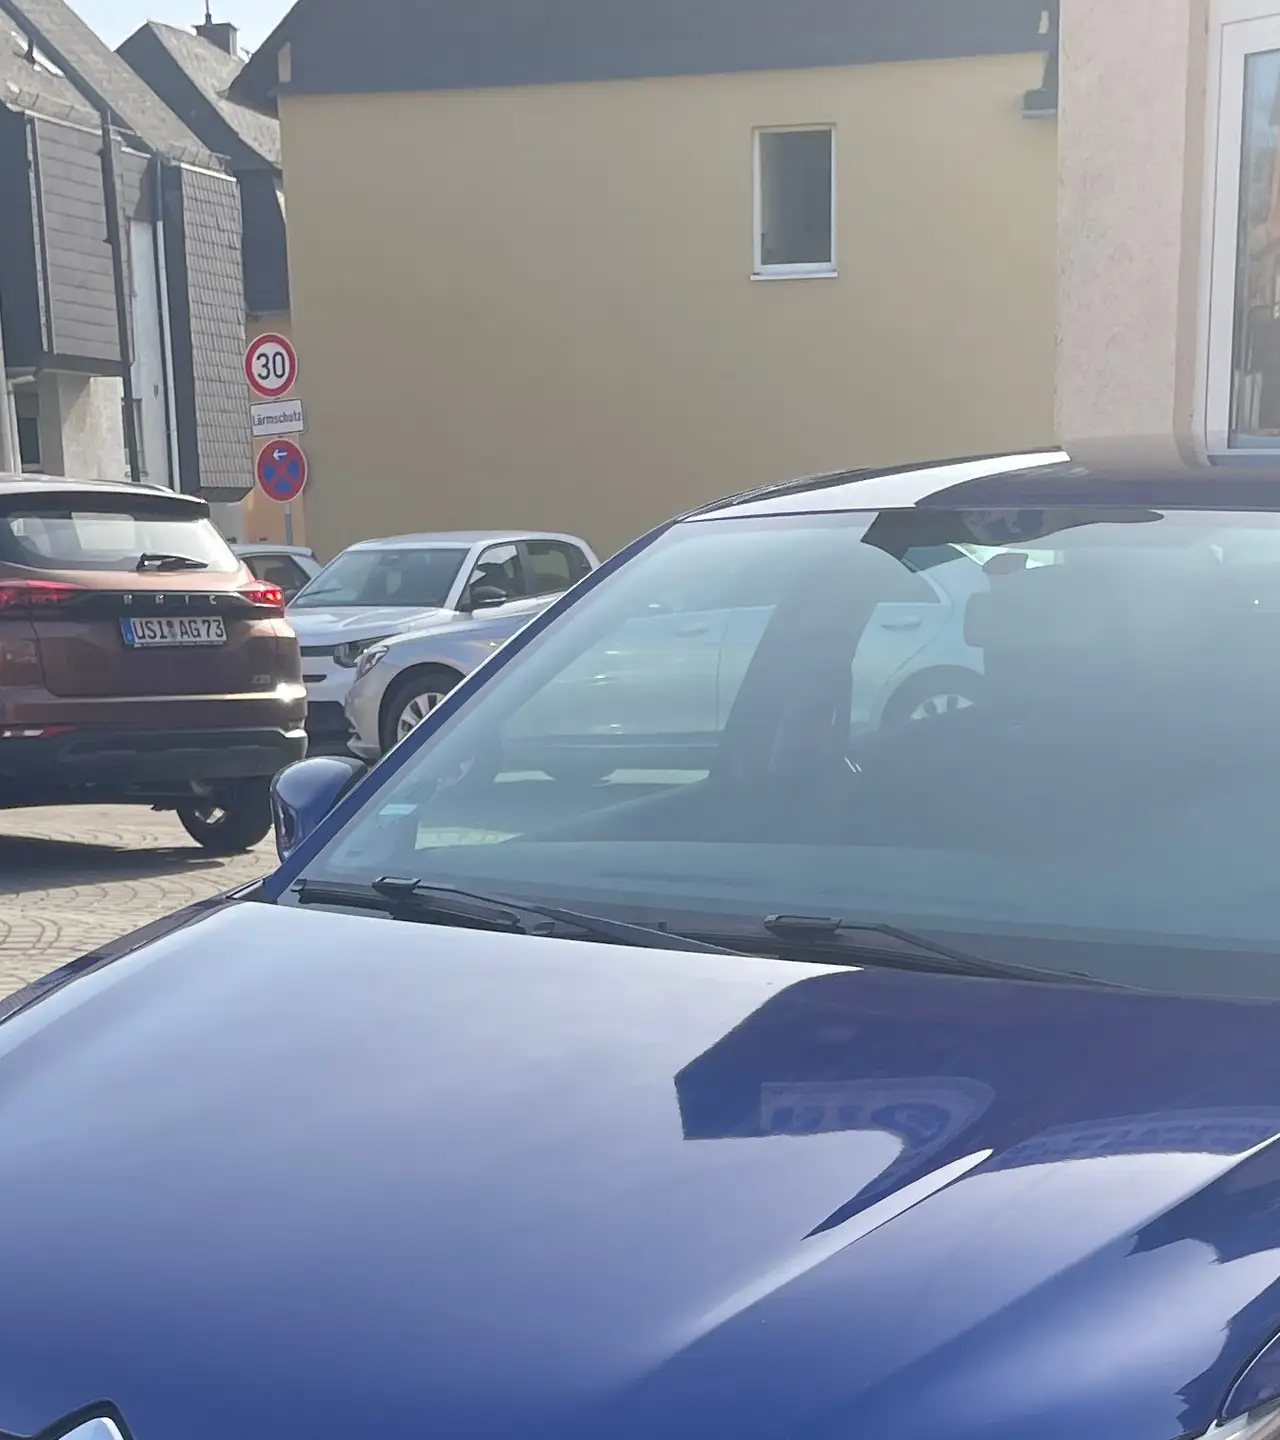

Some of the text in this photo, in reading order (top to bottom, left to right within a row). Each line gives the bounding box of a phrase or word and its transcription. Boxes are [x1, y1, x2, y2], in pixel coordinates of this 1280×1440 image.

[256, 351, 286, 380] 30
[252, 410, 302, 427] Lärmschutz
[133, 620, 168, 640] USI
